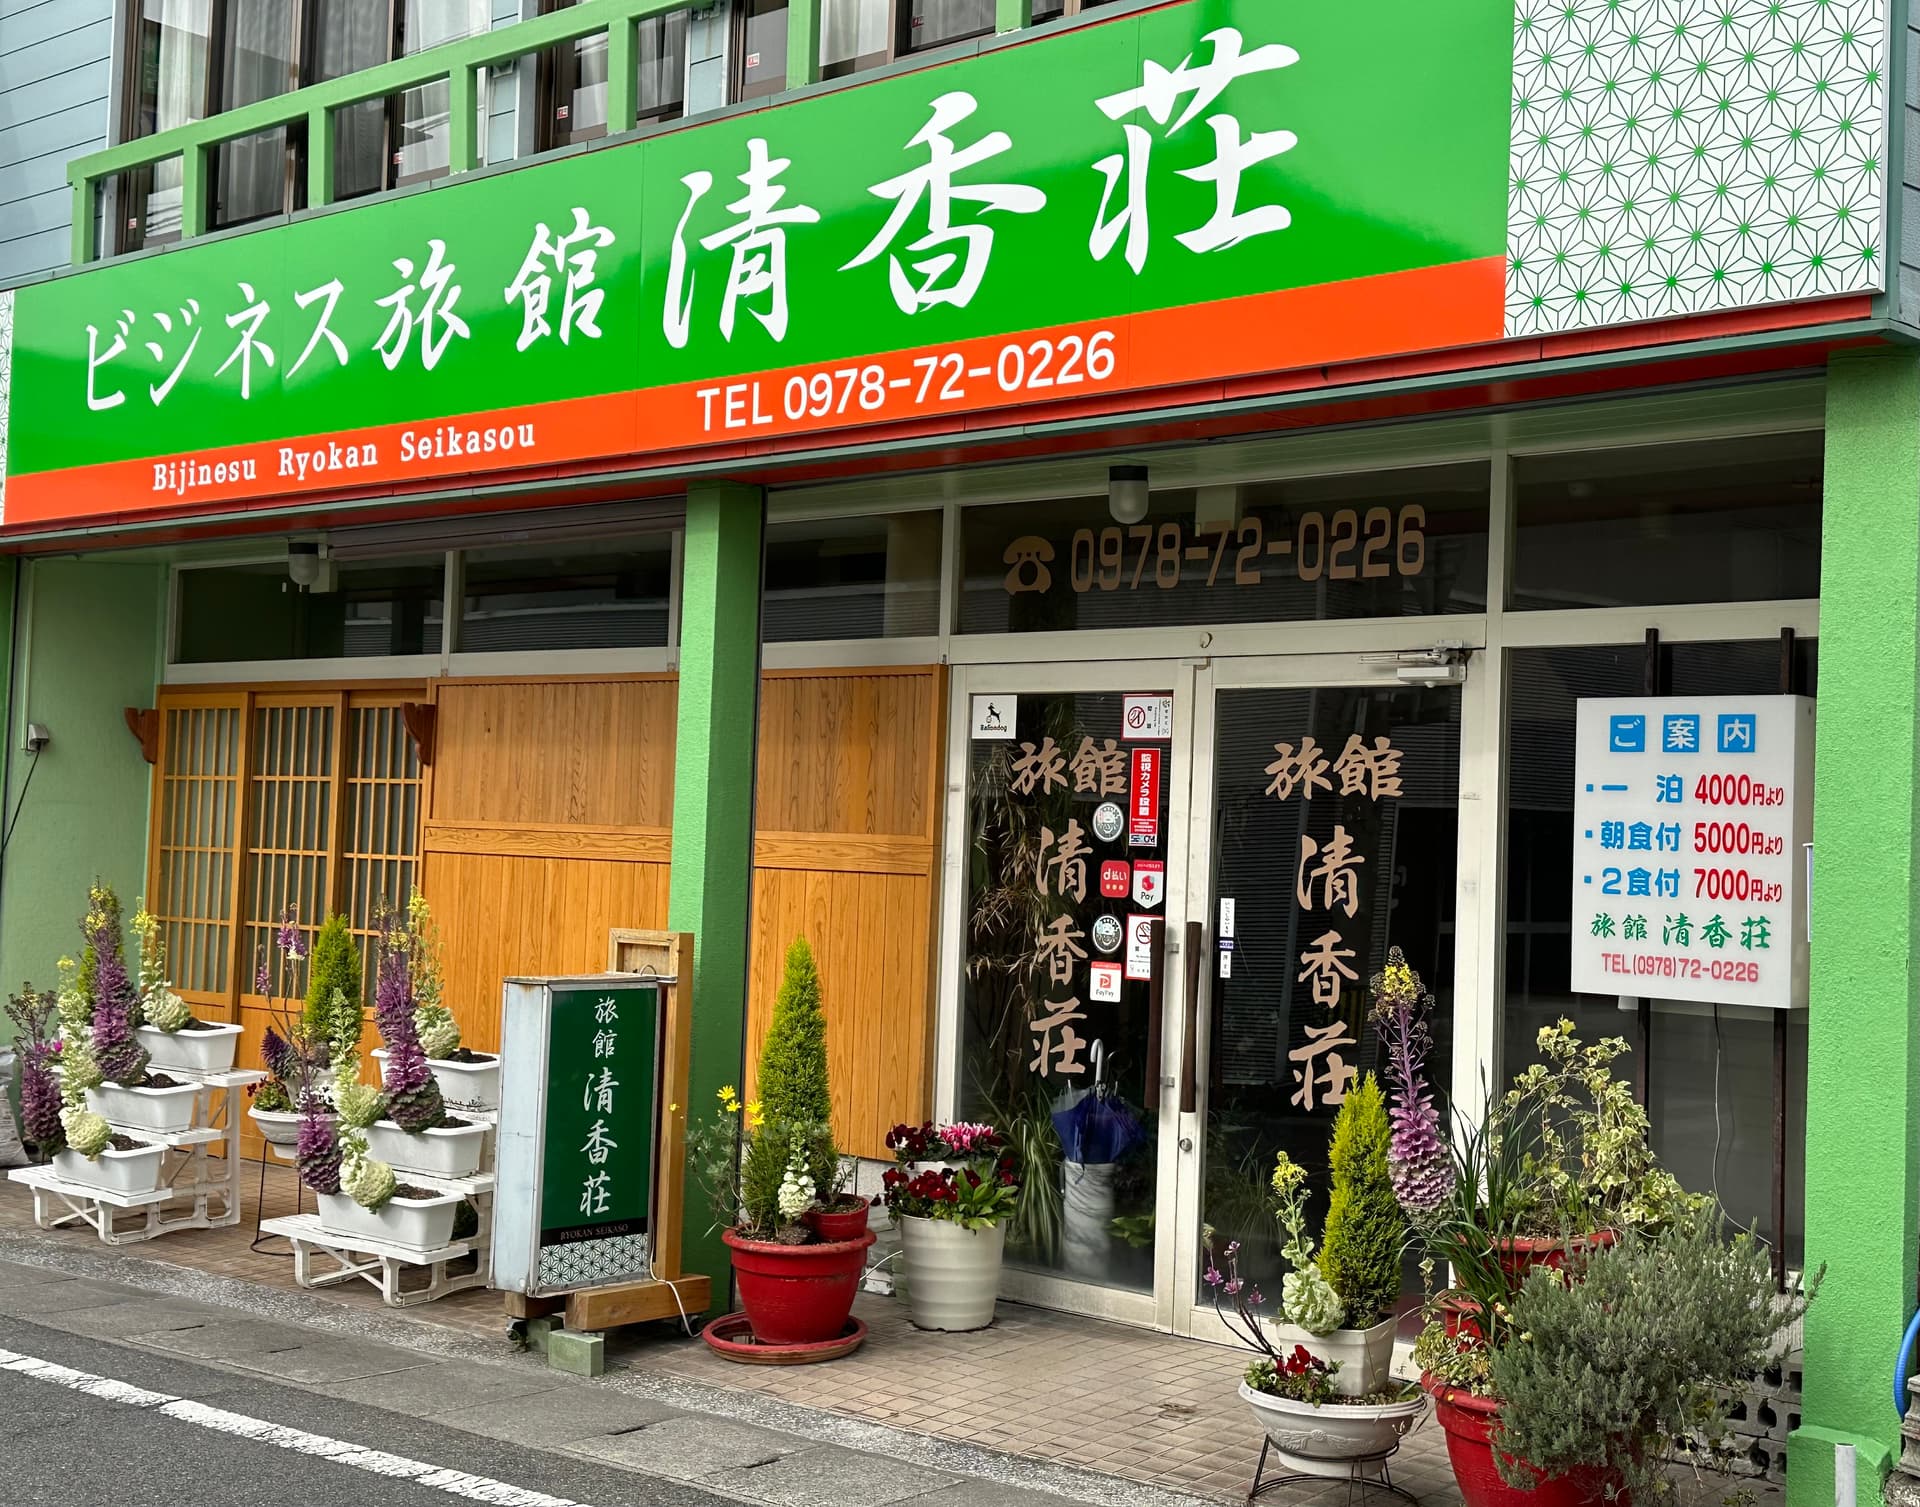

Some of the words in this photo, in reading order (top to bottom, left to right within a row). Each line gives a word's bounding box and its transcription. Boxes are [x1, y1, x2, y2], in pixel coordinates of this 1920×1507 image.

[697, 383, 772, 431] TEL
[783, 330, 1116, 414] 0978-72-0226
[153, 460, 257, 496] Bijinesu
[278, 442, 378, 480] Ryokan
[400, 423, 535, 462] Seikasou
[1071, 504, 1426, 593] 0978-72-0226
[1011, 735, 1128, 798] 旅館
[1264, 733, 1404, 802] 旅館
[1615, 717, 1750, 750] ご案内
[1600, 821, 1682, 852] 朝食付
[1140, 891, 1155, 902] Pay
[1030, 818, 1093, 1078] 清香荘
[1288, 825, 1365, 1112] 清香荘
[560, 1228, 593, 1241] RYOKAN
[595, 1223, 629, 1236] SEIKASO
